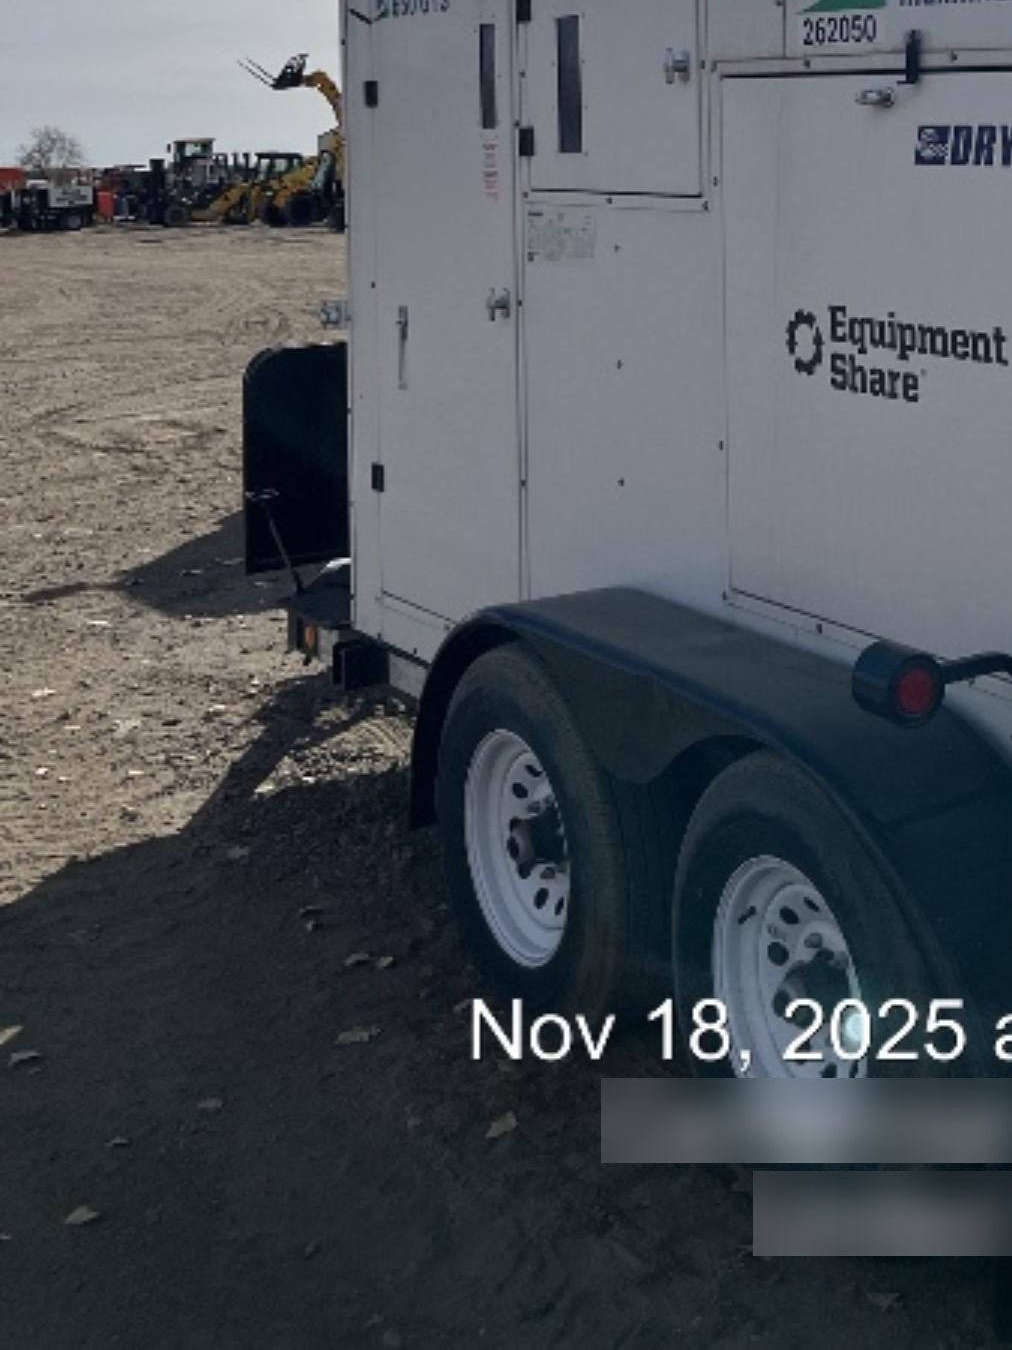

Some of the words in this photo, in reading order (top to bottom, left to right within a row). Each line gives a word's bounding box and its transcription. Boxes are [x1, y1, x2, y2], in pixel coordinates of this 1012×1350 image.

[803, 14, 877, 46] 262050
[828, 304, 1009, 367] Equipment
[830, 352, 919, 403] Share
